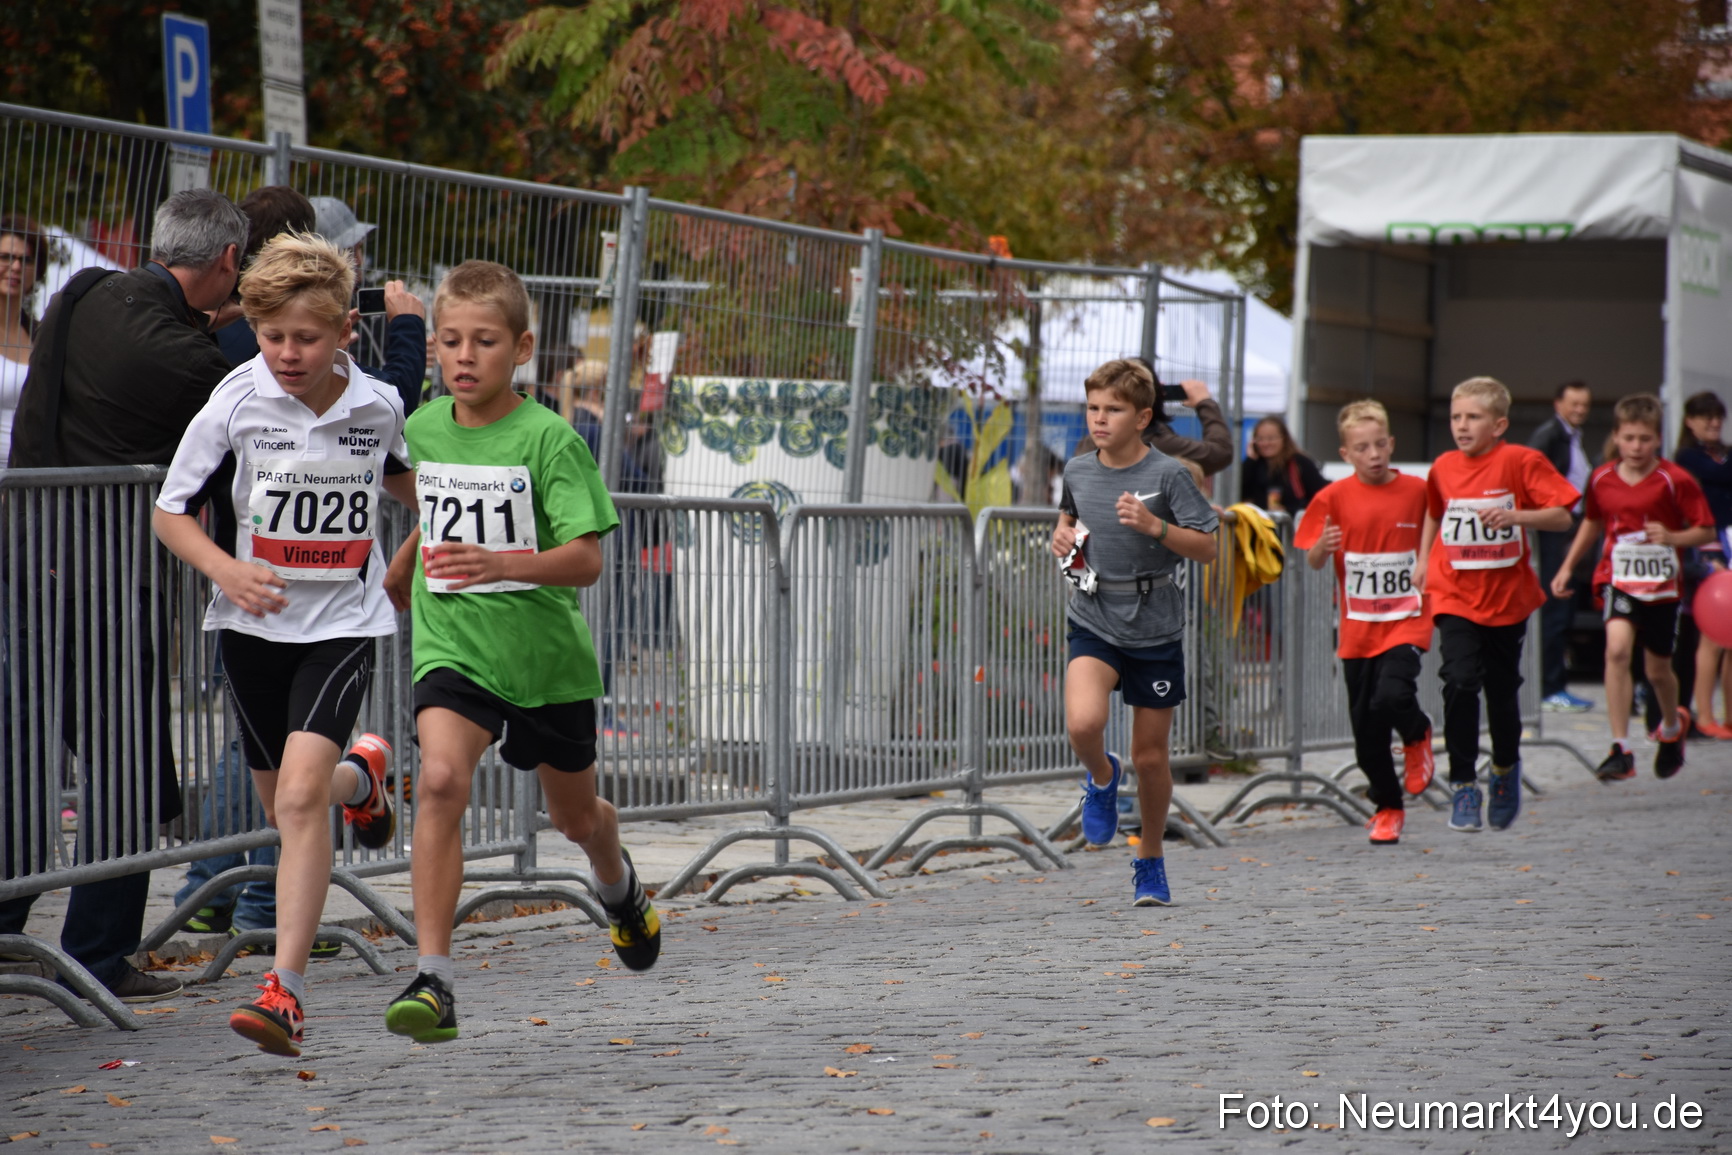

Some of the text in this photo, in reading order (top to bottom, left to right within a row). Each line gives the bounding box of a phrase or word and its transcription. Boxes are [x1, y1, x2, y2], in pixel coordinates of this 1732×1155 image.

[175, 36, 199, 132] P
[348, 427, 375, 435] SPORT
[253, 439, 296, 450] Vincent
[338, 435, 380, 448] MÜNCH
[257, 471, 362, 485] PARTL Neumarkt
[448, 478, 505, 492] Neumarkt
[266, 490, 369, 534] 7028
[424, 495, 516, 544] 7211
[283, 546, 347, 564] Vincent
[1619, 558, 1675, 579] 7005
[1352, 569, 1412, 595] 7186
